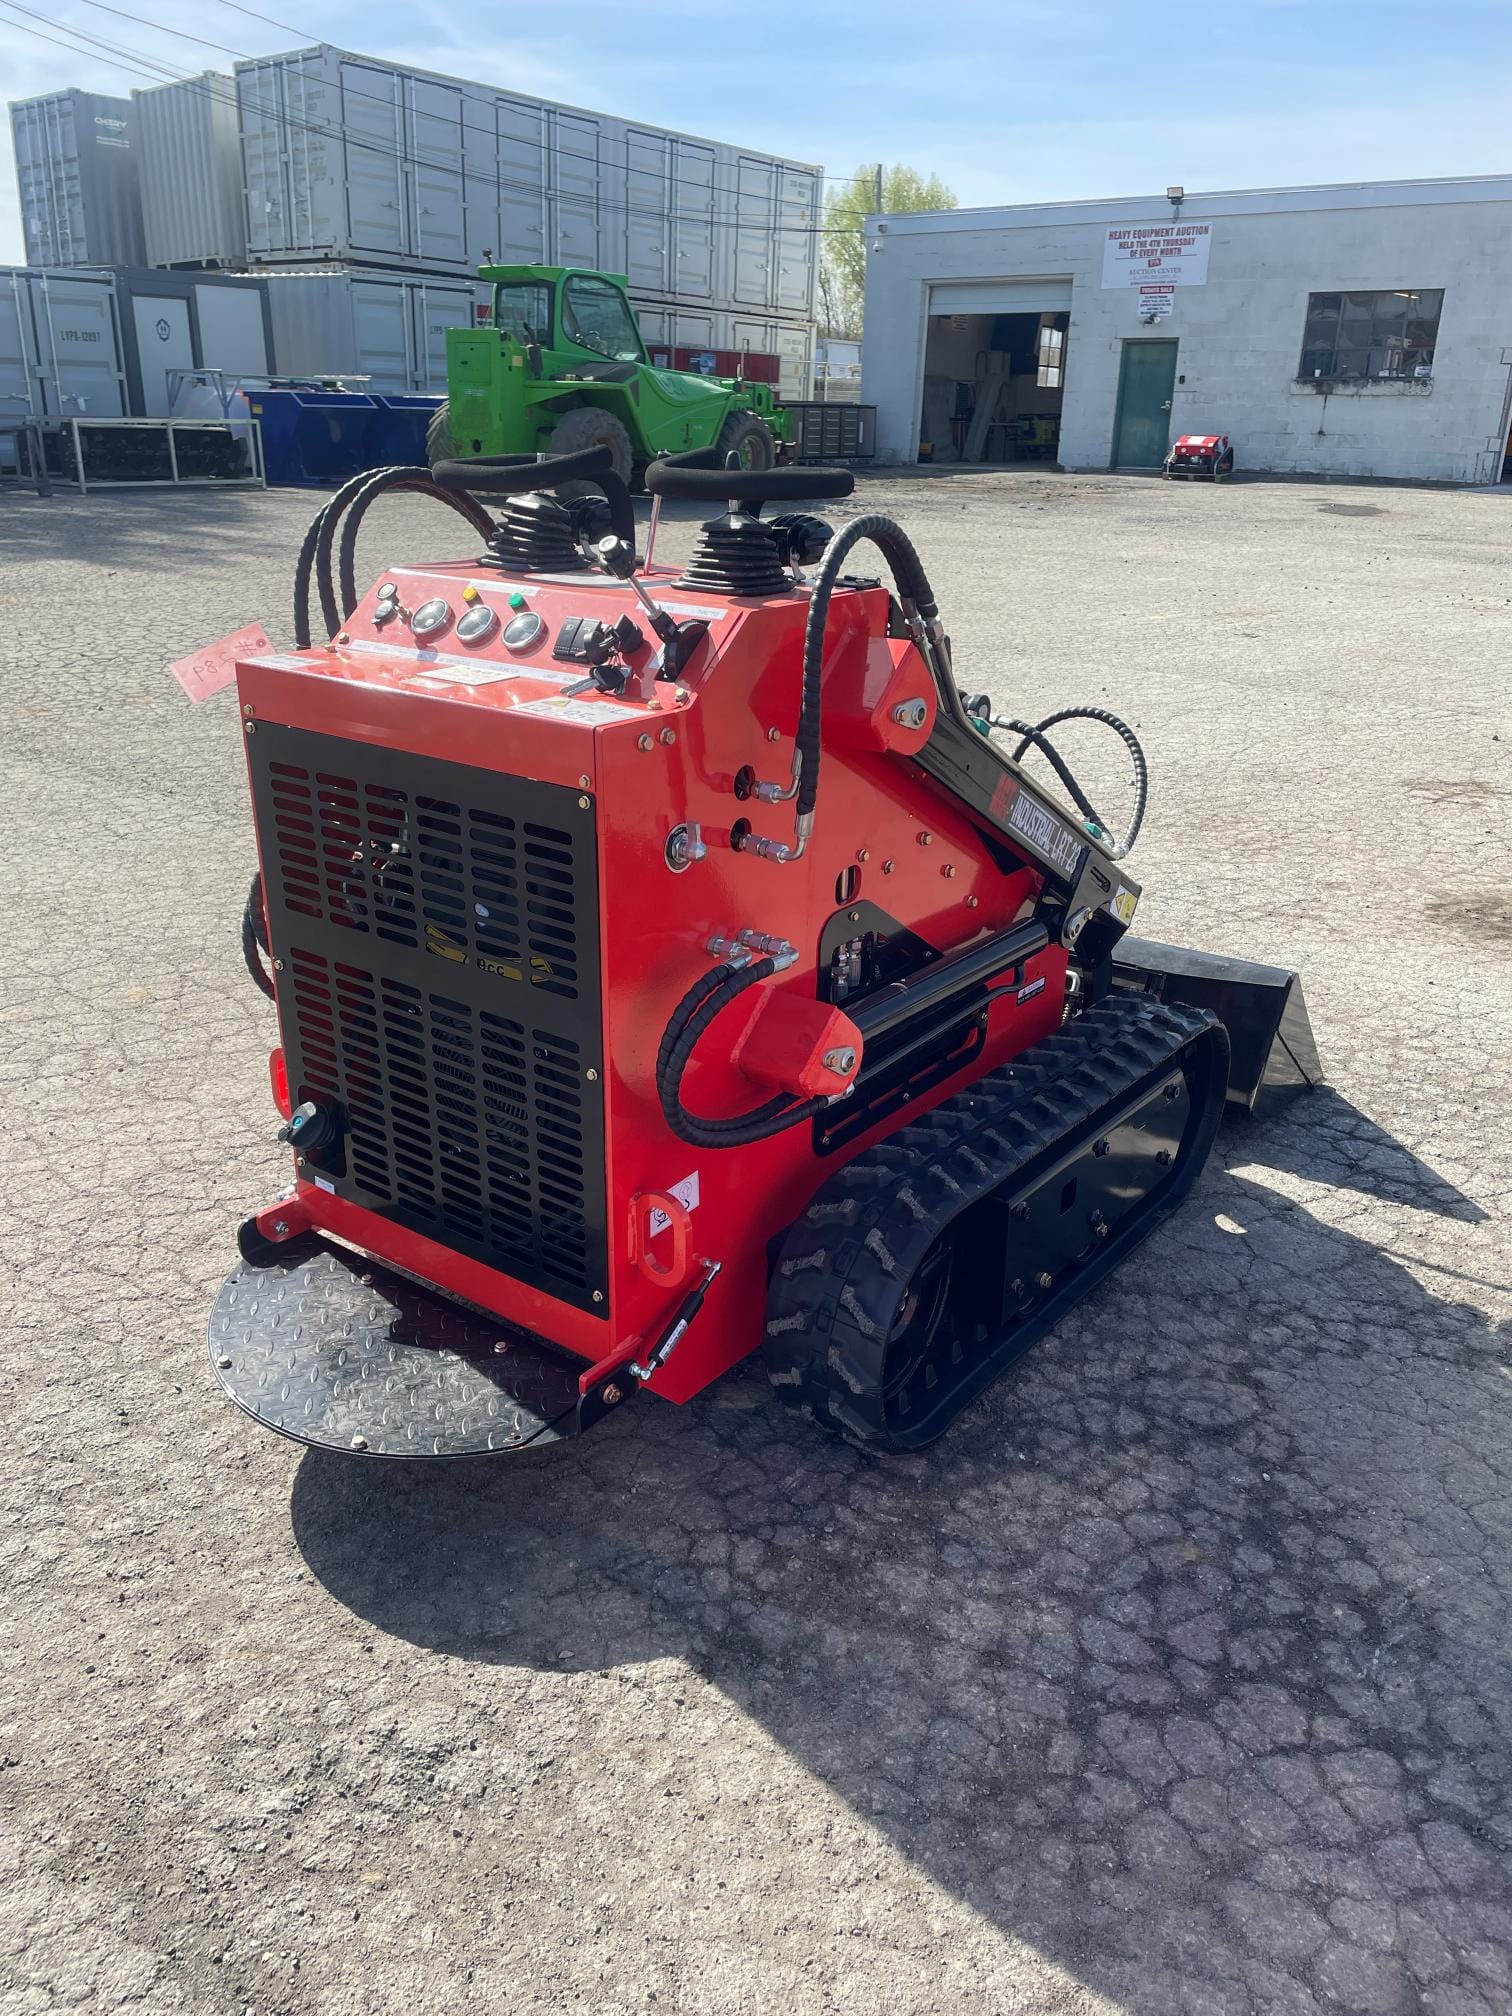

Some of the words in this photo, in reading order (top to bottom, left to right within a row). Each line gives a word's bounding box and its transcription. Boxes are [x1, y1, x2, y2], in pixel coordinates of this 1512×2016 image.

[1109, 231, 1131, 240] HEAVY
[1132, 228, 1175, 239] EQUIPMENT
[1176, 225, 1209, 236] AUCTION
[1119, 241, 1135, 249] HELD
[1136, 240, 1148, 249] THE
[1149, 239, 1161, 247] 4TH
[1162, 238, 1196, 247] THURSDAY
[1139, 248, 1158, 257] EVERY
[1159, 247, 1181, 256] MONTH
[1010, 794, 1055, 852] INDUSTRIAL
